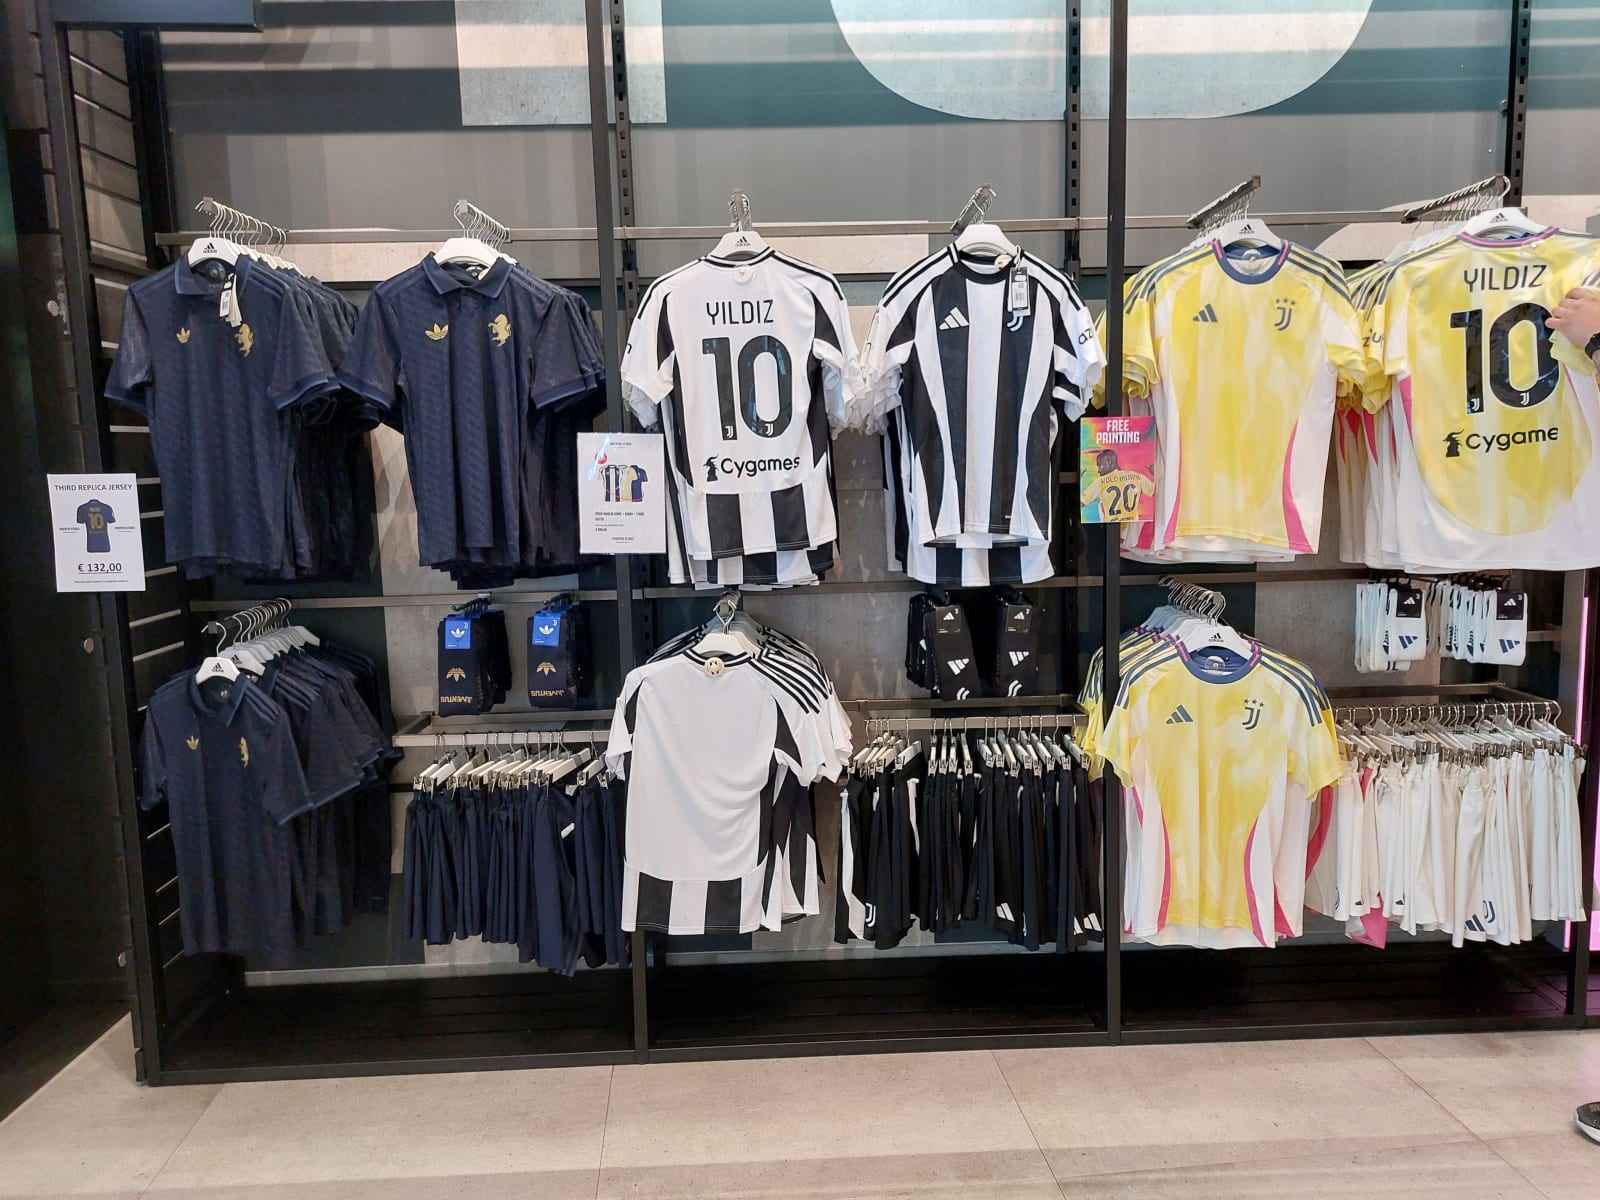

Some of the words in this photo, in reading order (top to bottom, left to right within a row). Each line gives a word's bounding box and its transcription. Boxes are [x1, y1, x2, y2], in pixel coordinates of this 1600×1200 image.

[1463, 264, 1547, 293] YILDIZ
[706, 299, 774, 325] YILDIZ
[1449, 302, 1560, 415] 10
[702, 334, 792, 441] 10
[1096, 431, 1140, 444] PRINTING
[1106, 419, 1130, 432] FREE
[720, 456, 800, 478] Cygames
[108, 483, 133, 491] JERSEY
[1106, 483, 1138, 516] 20
[78, 563, 84, 572] €
[87, 562, 122, 573] 132,00
